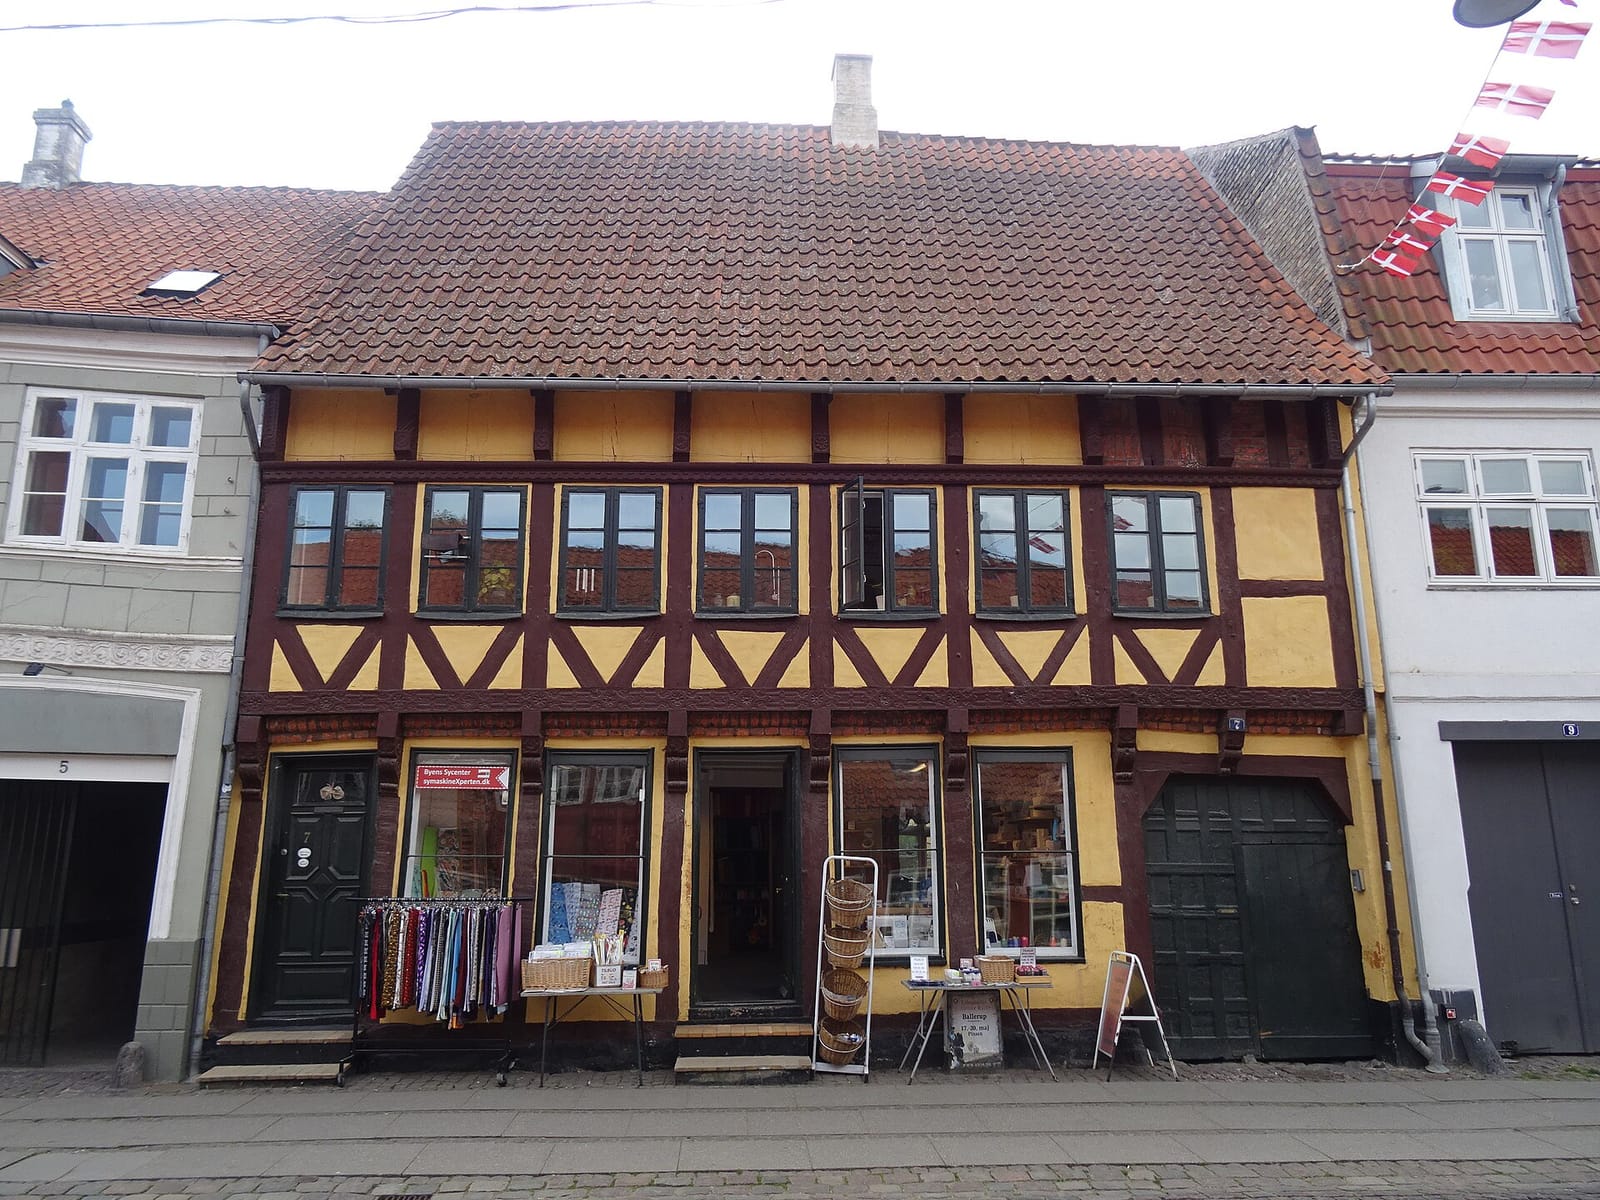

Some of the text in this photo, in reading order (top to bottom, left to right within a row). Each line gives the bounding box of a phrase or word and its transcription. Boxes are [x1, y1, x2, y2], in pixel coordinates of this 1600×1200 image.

[1234, 719, 1241, 730] 7
[1568, 725, 1575, 735] 9
[59, 760, 69, 774] 5
[423, 768, 471, 776] Byens Sycenter
[423, 777, 491, 785] symaskineXperten.dk
[303, 831, 311, 844] 7
[962, 1013, 988, 1021] Ballerup
